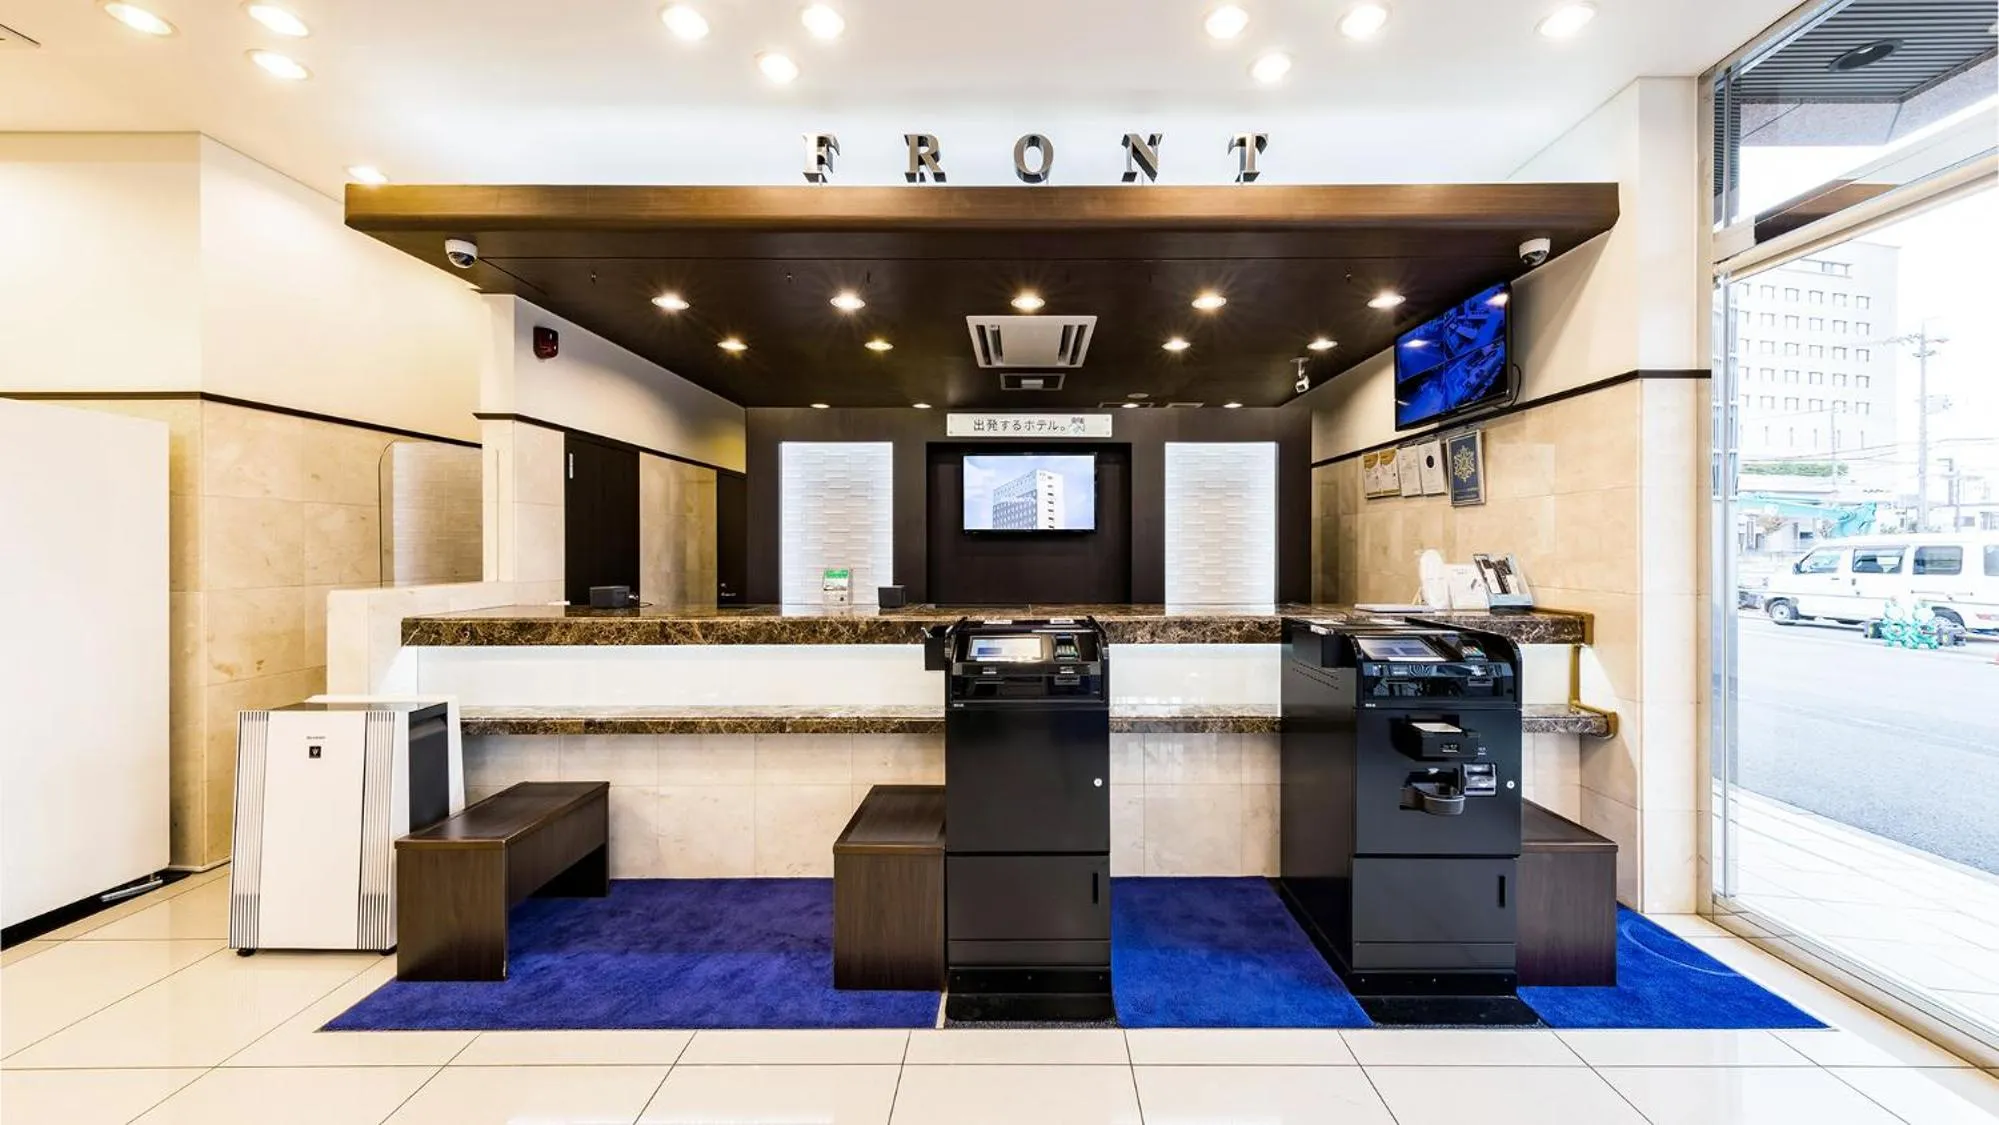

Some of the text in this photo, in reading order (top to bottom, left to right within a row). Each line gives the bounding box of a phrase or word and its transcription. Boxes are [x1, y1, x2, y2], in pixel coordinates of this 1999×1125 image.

[802, 133, 1268, 183] FRONT
[973, 420, 1066, 432] 出発するホテル。
